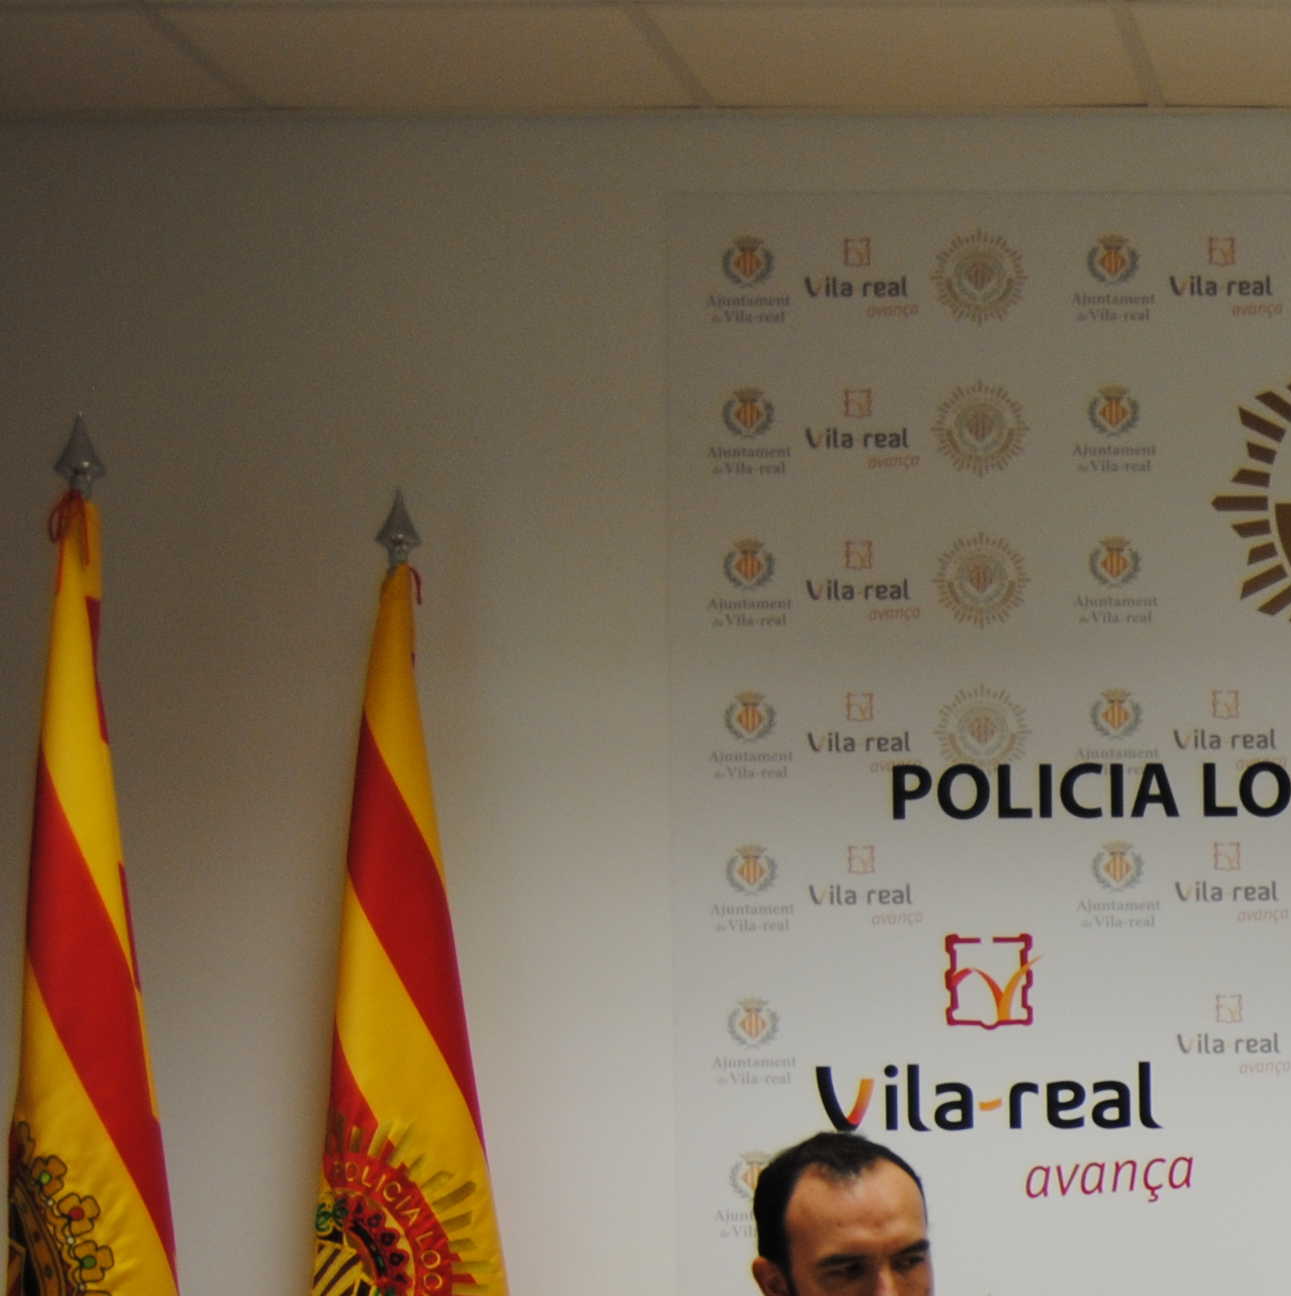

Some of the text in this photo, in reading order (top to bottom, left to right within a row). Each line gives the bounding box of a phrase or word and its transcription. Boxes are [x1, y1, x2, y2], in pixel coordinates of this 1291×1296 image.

[891, 761, 1180, 820] POLICIA
[815, 1061, 1164, 1132] Vila-real
[334, 1161, 422, 1228] POLICIA
[1025, 1152, 1195, 1203] avança
